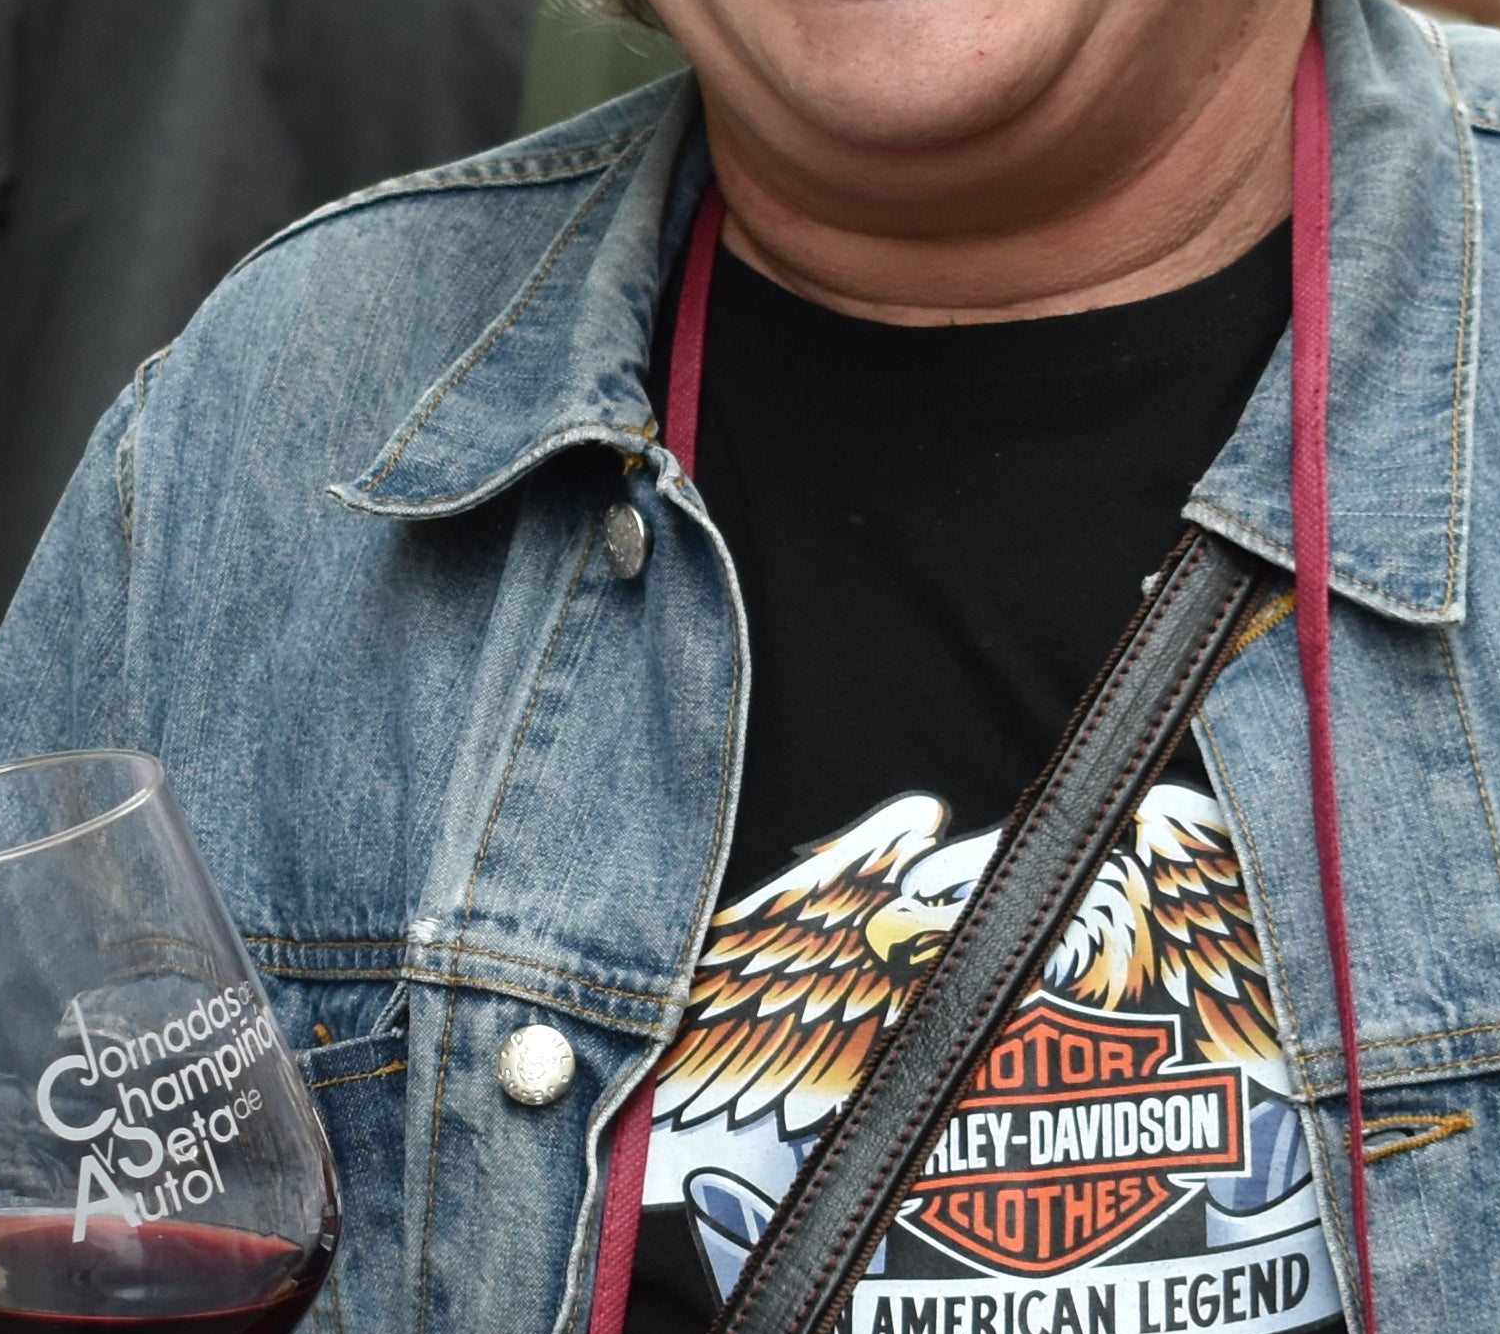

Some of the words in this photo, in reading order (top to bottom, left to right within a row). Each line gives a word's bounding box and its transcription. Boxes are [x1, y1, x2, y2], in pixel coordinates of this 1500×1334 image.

[37, 1003, 274, 1141] Champiñó
[71, 987, 241, 1086] Jornadas
[112, 1104, 240, 1178] Seta
[233, 1088, 263, 1120] de
[920, 1092, 1220, 1176] RLEY-DAVIDSON
[72, 1139, 226, 1244] Autol
[949, 1178, 1142, 1259] CLOTHES
[1137, 1252, 1311, 1334] LEGEND
